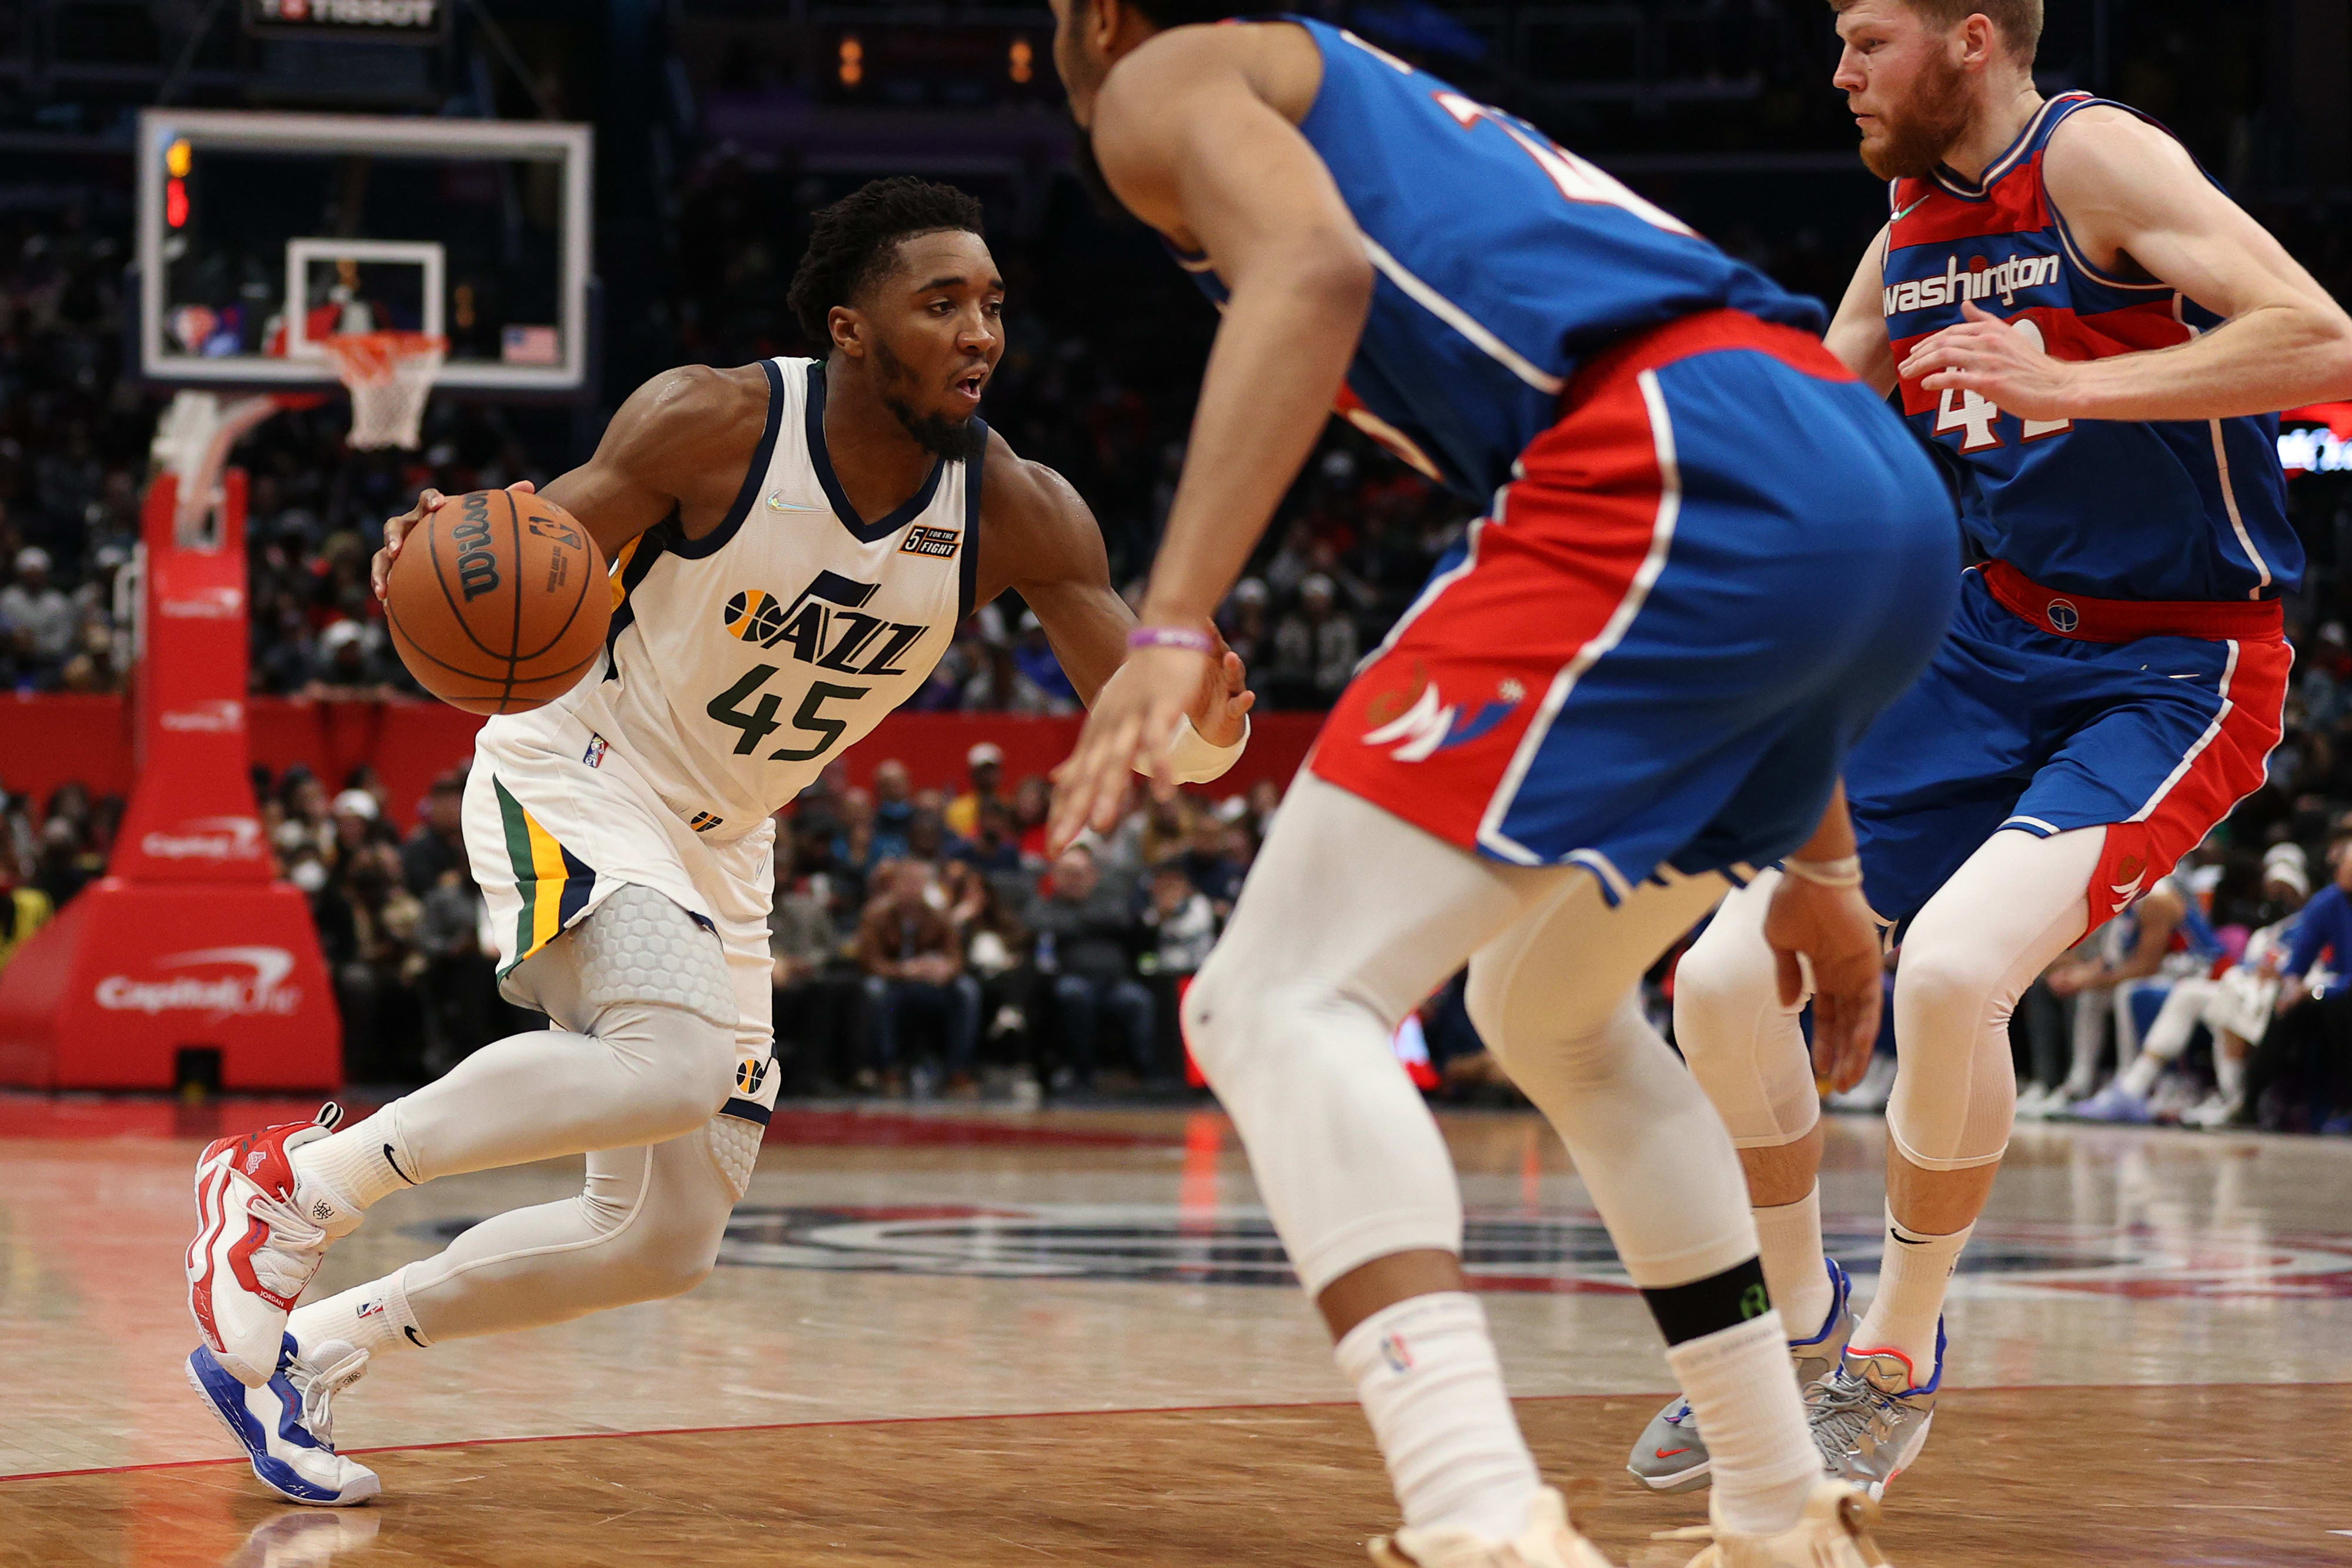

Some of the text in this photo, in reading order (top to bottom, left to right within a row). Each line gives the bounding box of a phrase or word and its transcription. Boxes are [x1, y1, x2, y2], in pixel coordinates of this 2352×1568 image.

[1882, 253, 2060, 317] washington
[905, 529, 924, 550] 5
[928, 530, 942, 539] FOR
[920, 542, 955, 556] FIGHT
[724, 569, 930, 676] JAZZ
[706, 663, 873, 761] 45
[259, 1290, 285, 1308] JORDAN
